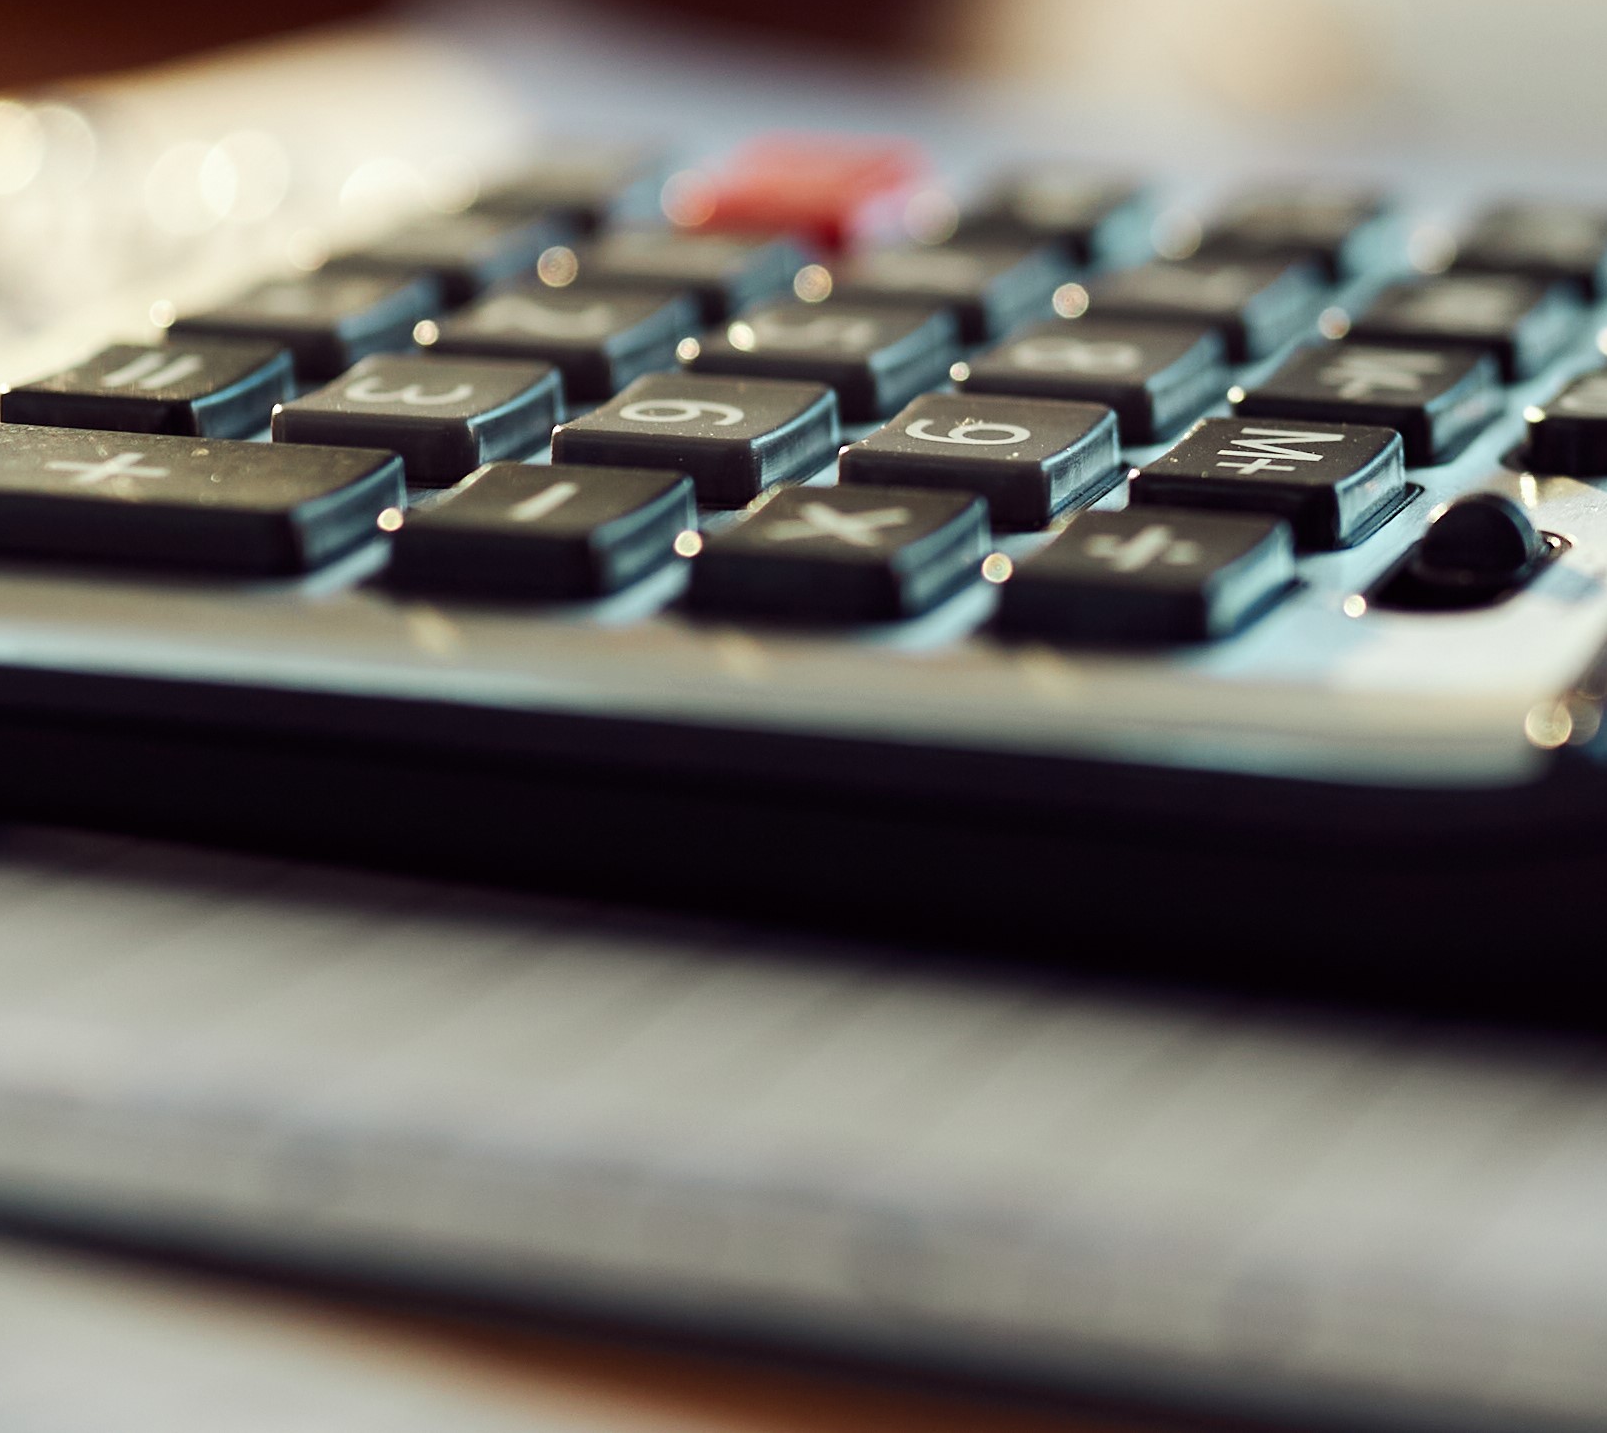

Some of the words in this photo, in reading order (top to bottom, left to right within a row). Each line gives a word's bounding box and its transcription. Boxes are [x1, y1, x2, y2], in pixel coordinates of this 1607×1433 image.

[346, 377, 474, 406] 3
[619, 398, 744, 426] 6
[905, 418, 1031, 445] 9
[1216, 427, 1345, 475] M+
